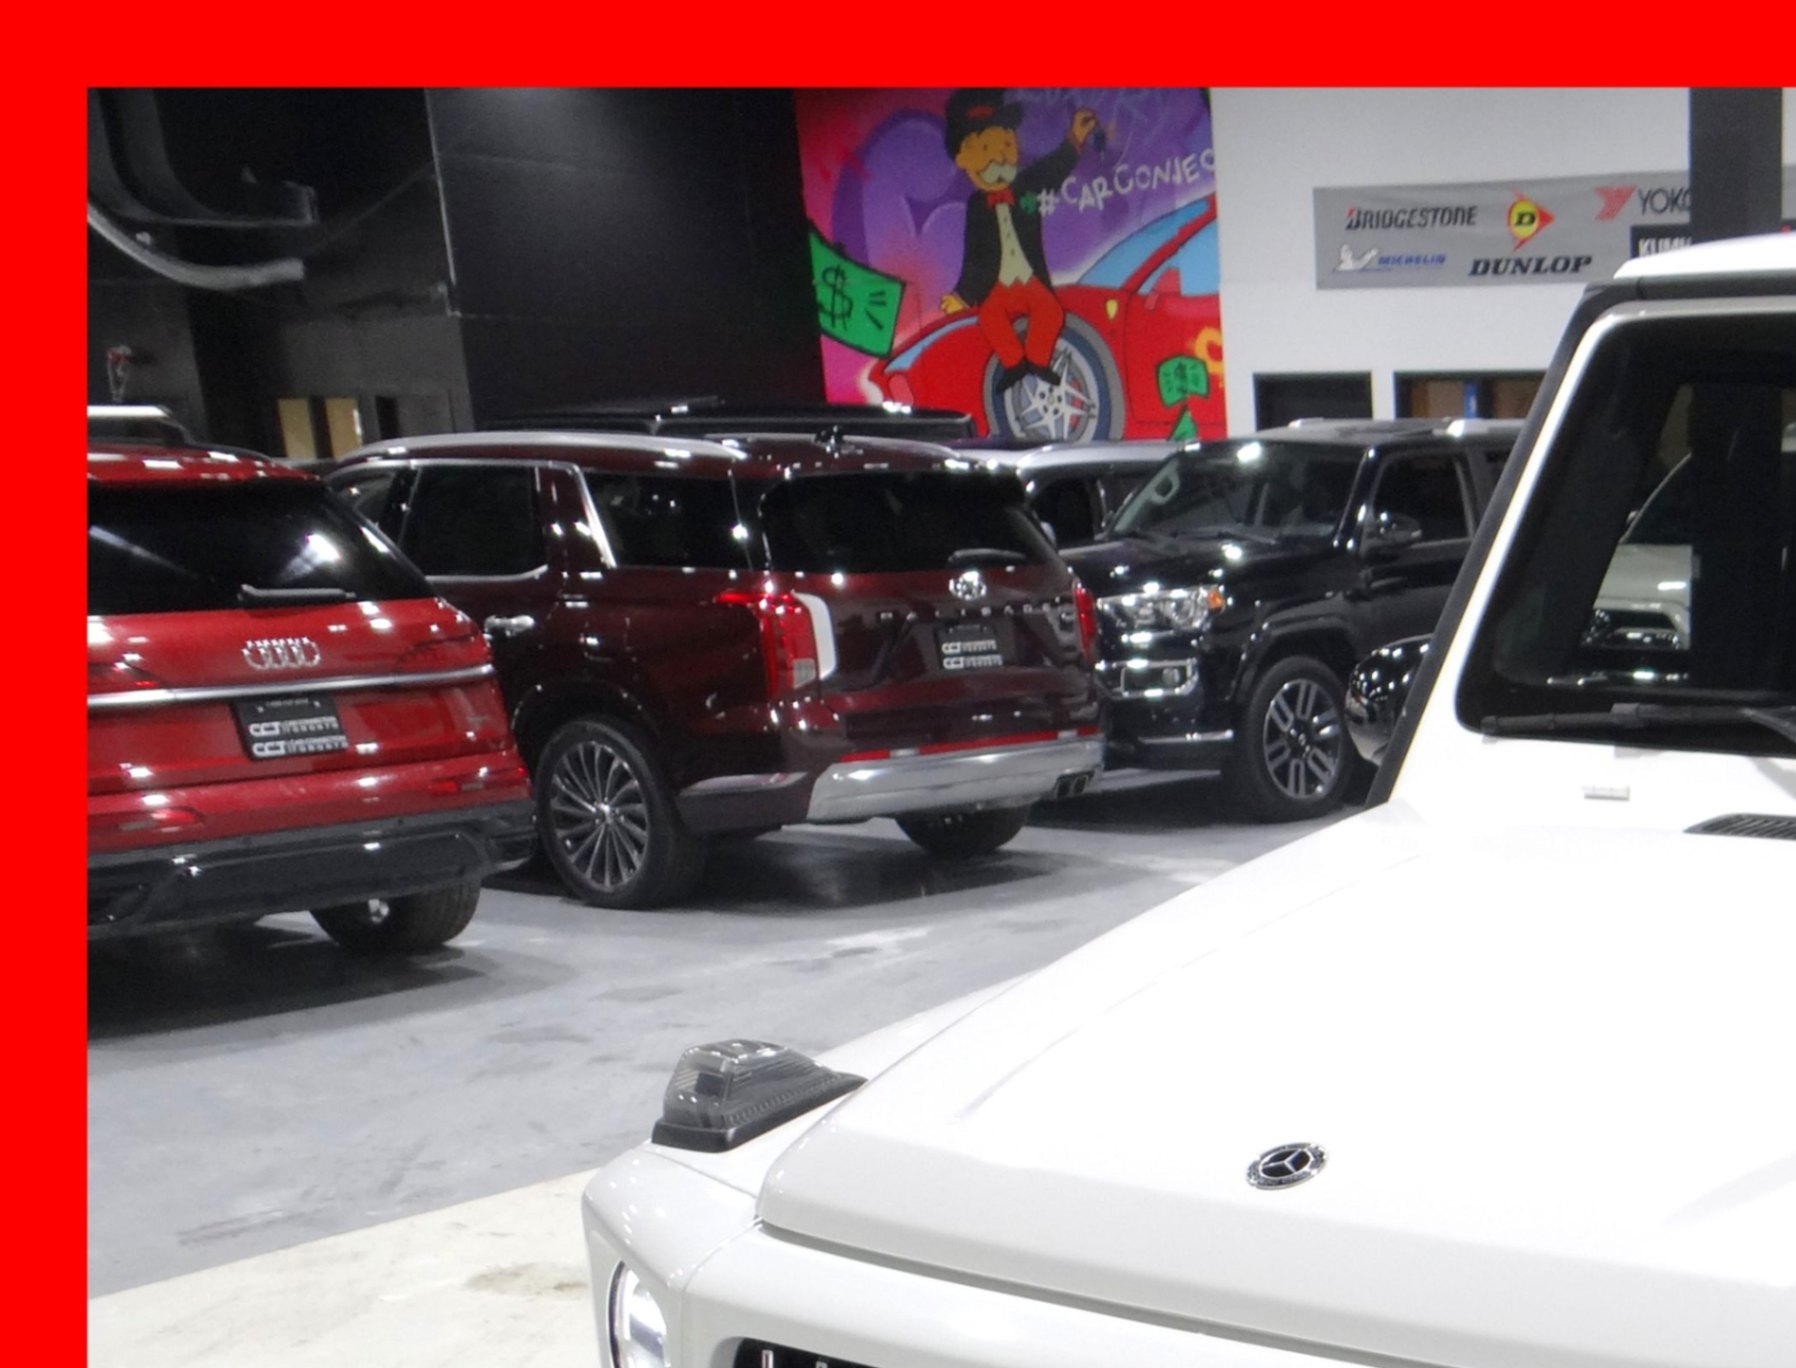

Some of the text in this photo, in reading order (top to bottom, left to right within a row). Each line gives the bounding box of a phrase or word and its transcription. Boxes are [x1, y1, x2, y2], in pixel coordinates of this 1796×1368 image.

[1345, 206, 1477, 230] BRIDGESTONE
[1377, 254, 1447, 265] MICHELIN
[1469, 255, 1592, 276] DUNLOP
